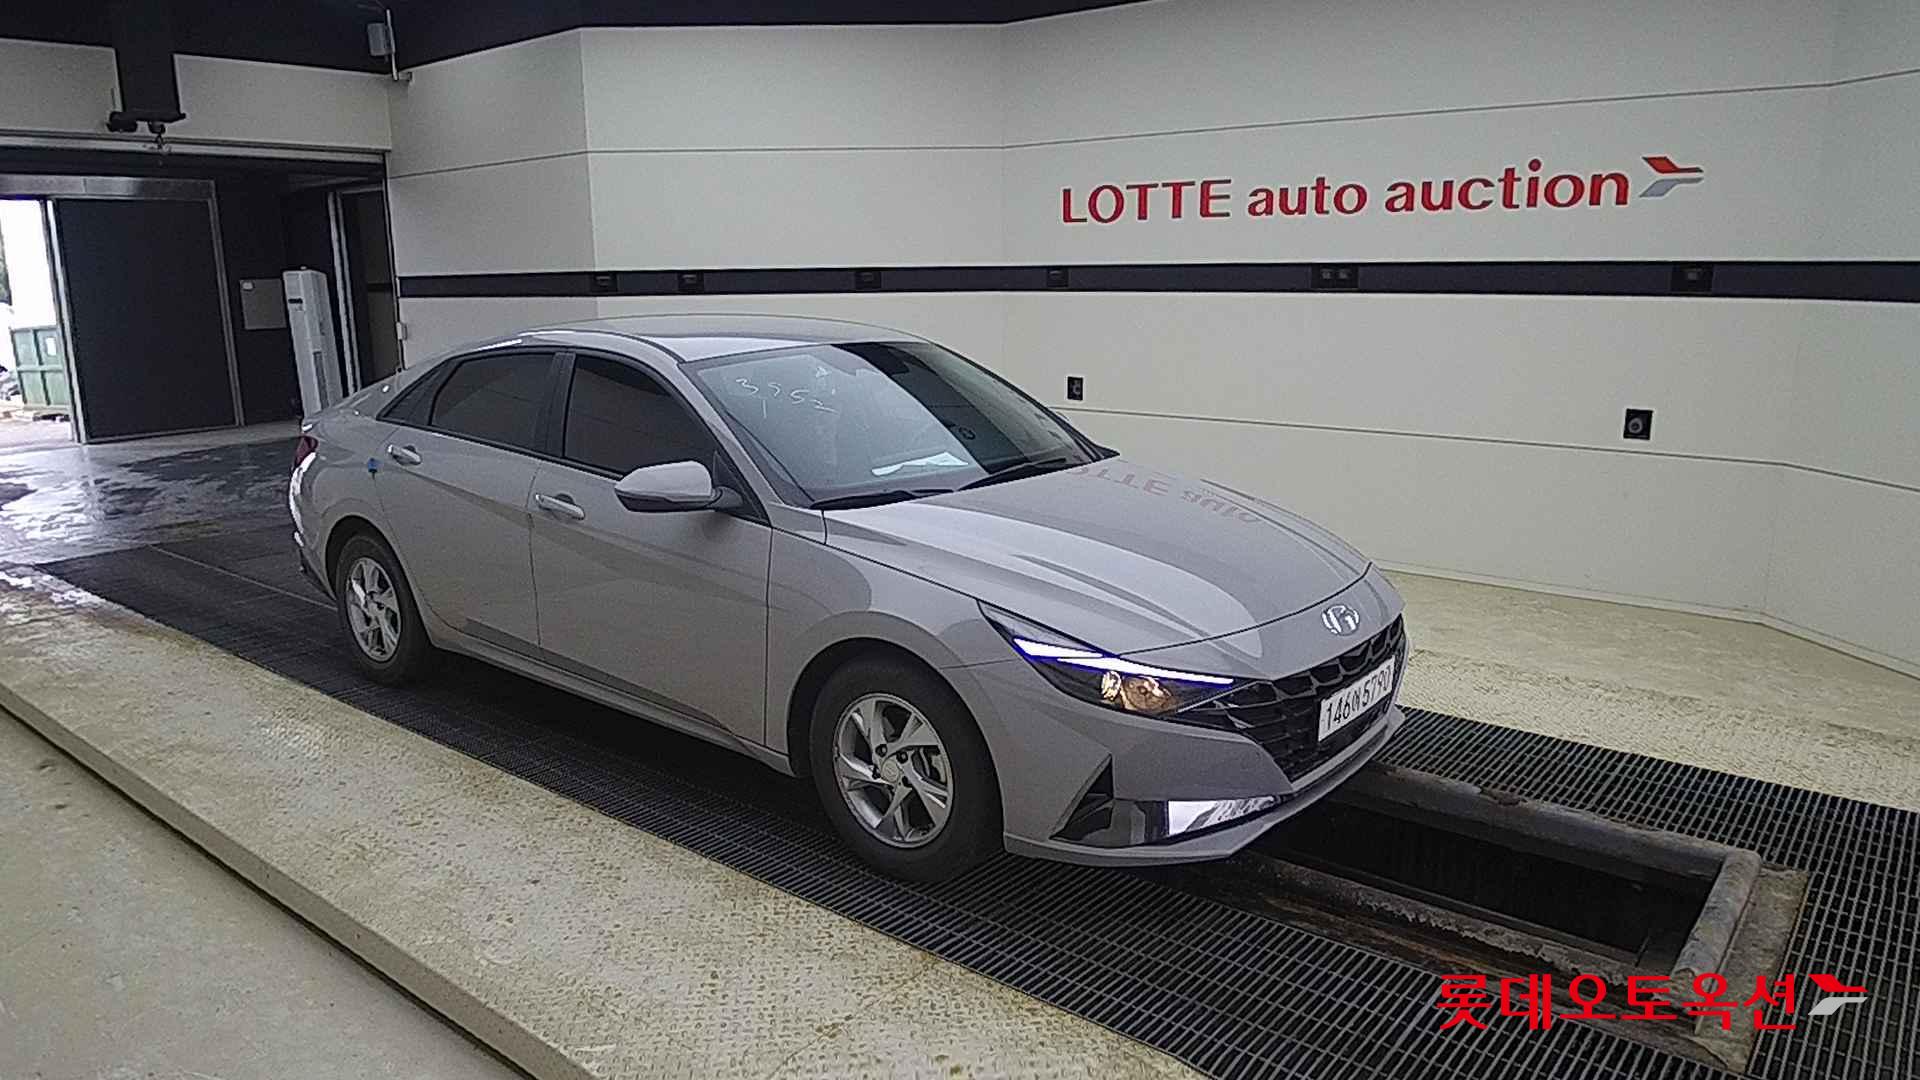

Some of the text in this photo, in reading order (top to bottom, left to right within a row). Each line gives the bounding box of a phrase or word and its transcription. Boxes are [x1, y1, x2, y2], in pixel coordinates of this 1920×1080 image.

[1061, 158, 1630, 223] LOTTE auto auction
